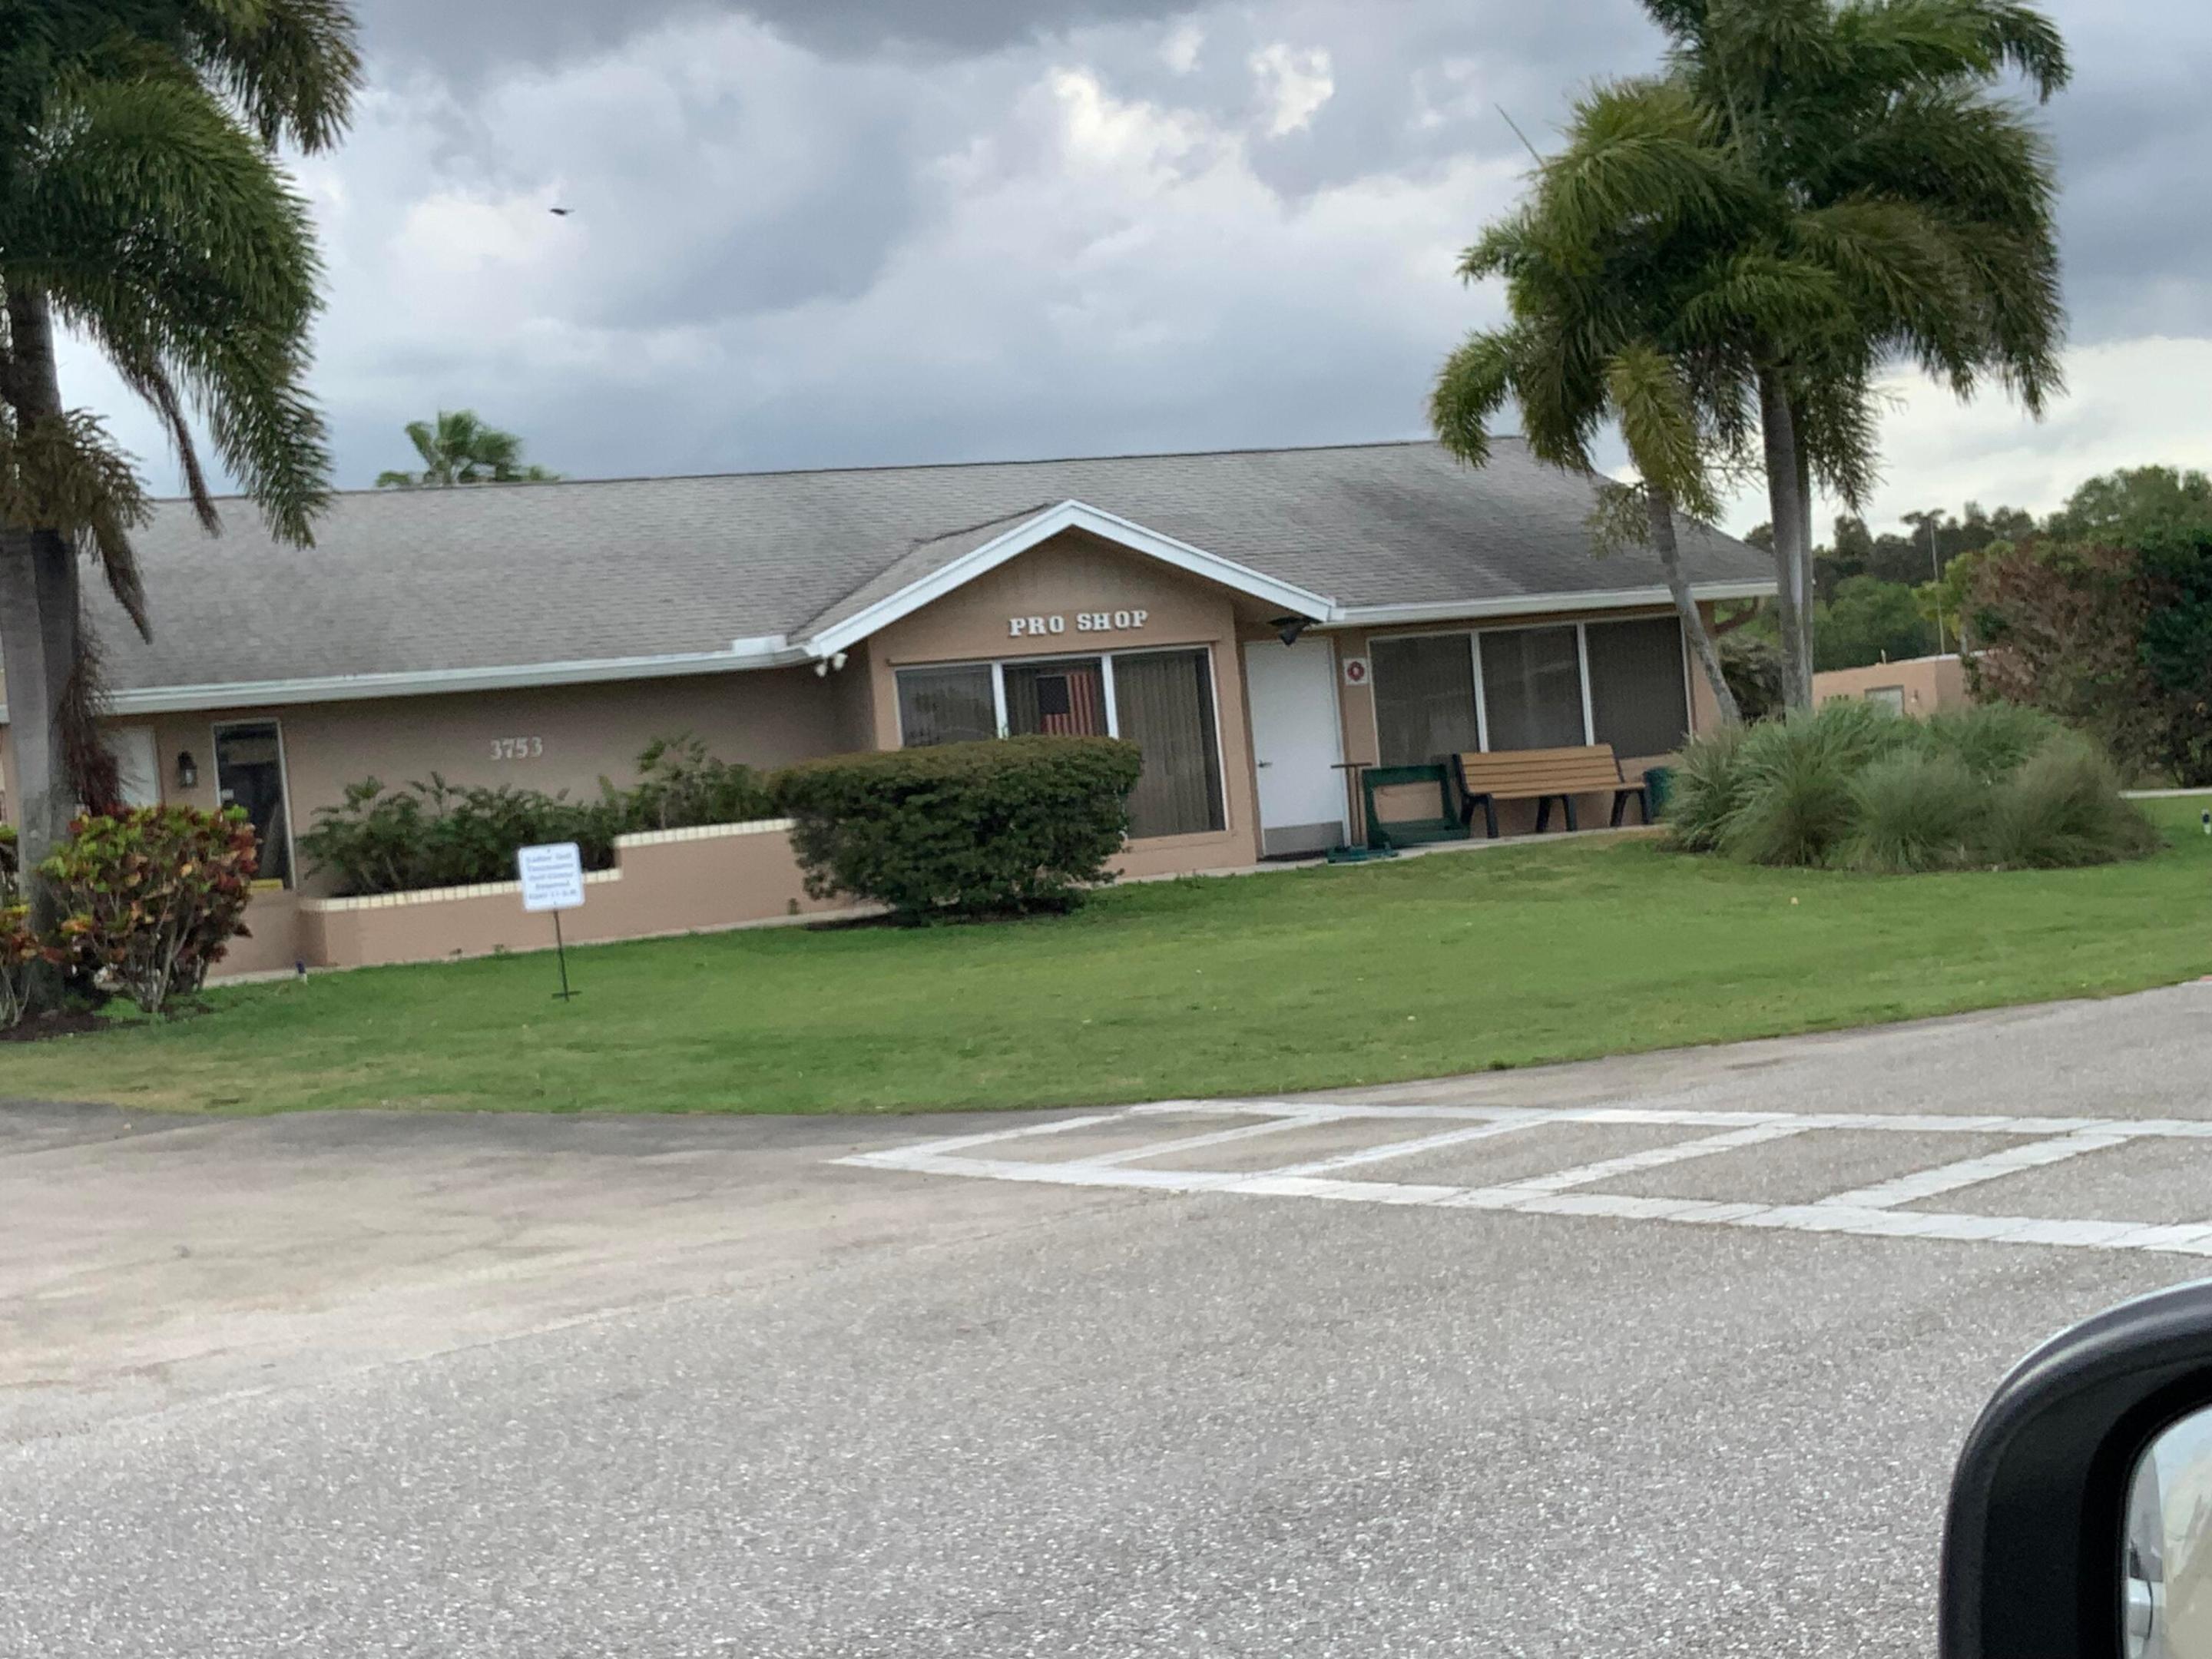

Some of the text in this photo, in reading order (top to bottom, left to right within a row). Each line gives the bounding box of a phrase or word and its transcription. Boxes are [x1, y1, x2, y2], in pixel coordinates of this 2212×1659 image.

[1008, 609, 1148, 637] PRO SHOP
[490, 737, 542, 760] 3753
